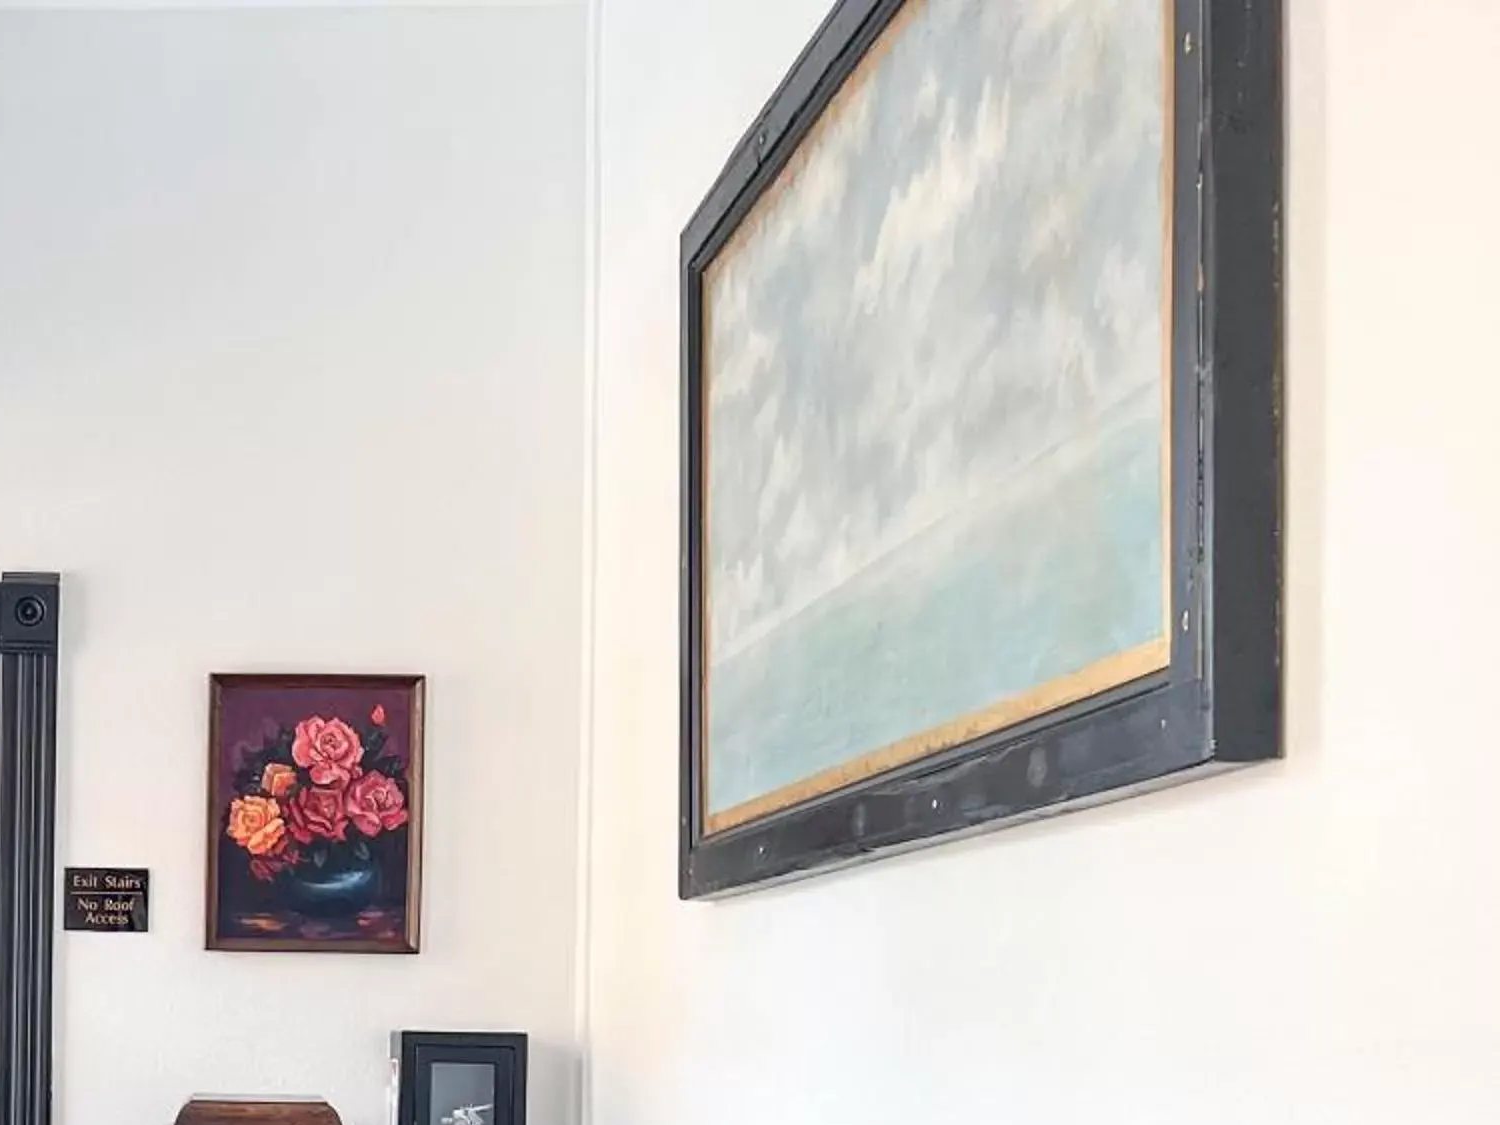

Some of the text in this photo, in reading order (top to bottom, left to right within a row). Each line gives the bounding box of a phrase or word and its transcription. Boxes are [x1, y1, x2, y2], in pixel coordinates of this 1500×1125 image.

[73, 874, 141, 889] Exit Stairs
[77, 898, 135, 911] No Roof
[85, 912, 129, 925] Access
